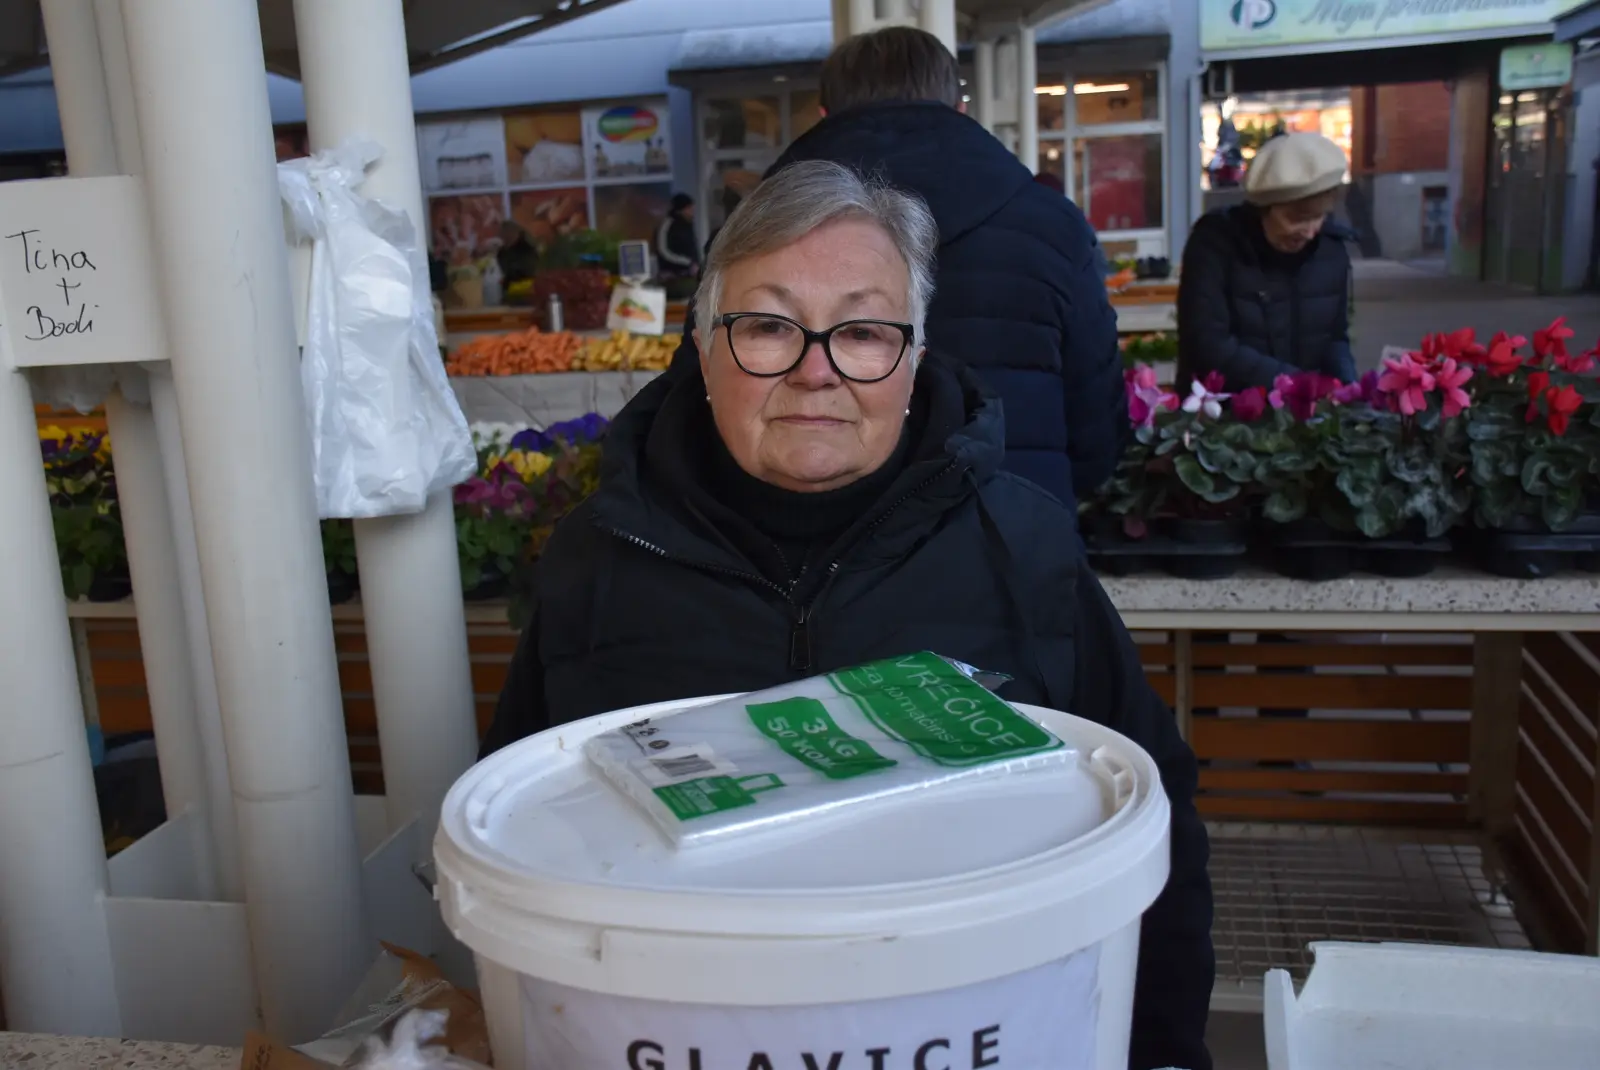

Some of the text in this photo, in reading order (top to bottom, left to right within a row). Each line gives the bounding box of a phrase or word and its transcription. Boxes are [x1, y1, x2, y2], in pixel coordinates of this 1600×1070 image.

[5, 229, 97, 274] Tina
[56, 277, 81, 306] +
[25, 303, 100, 341] Bodi
[766, 716, 799, 738] 50
[802, 716, 828, 735] 3
